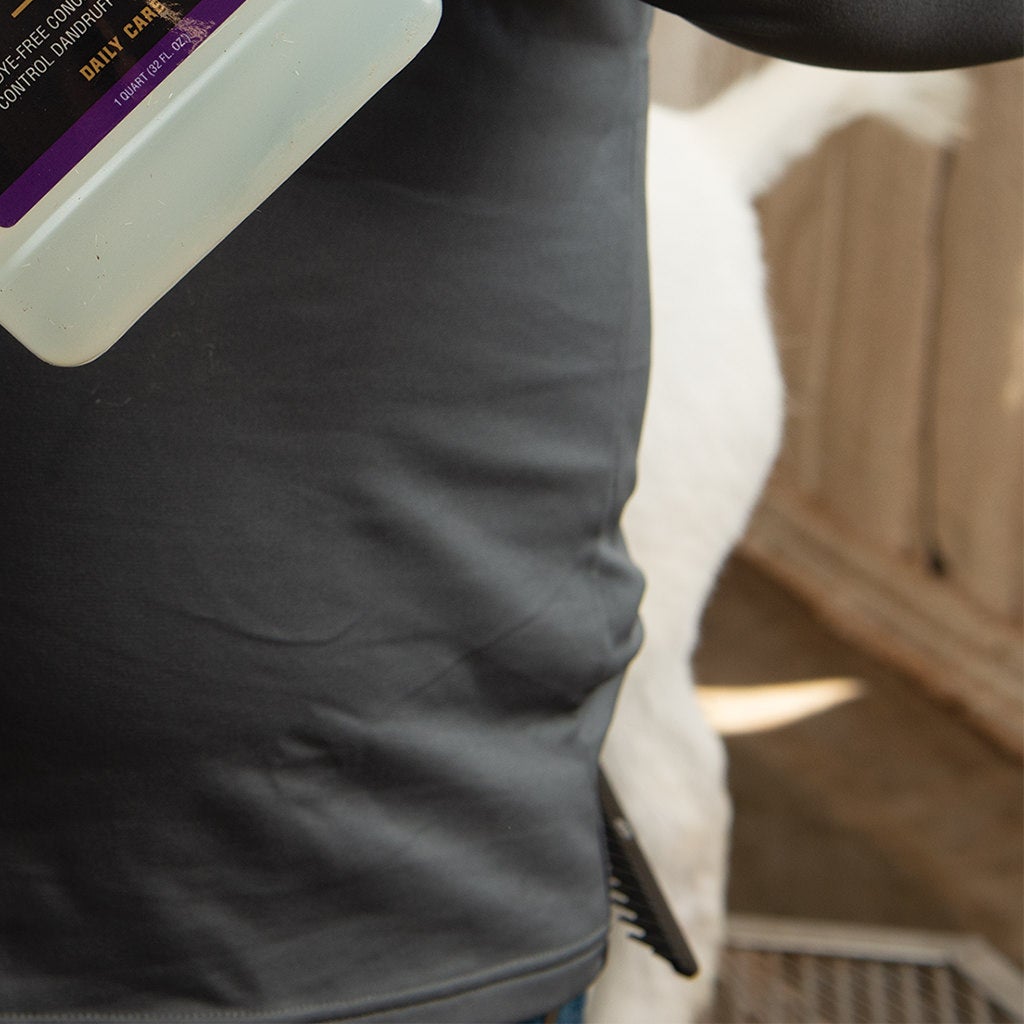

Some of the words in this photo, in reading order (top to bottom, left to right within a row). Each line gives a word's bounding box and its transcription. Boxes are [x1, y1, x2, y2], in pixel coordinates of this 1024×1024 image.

[79, 35, 124, 81] DAILY
[114, 98, 122, 106] 1
[119, 71, 148, 101] QUART
[146, 59, 163, 77] (32
[158, 51, 174, 64] FL.
